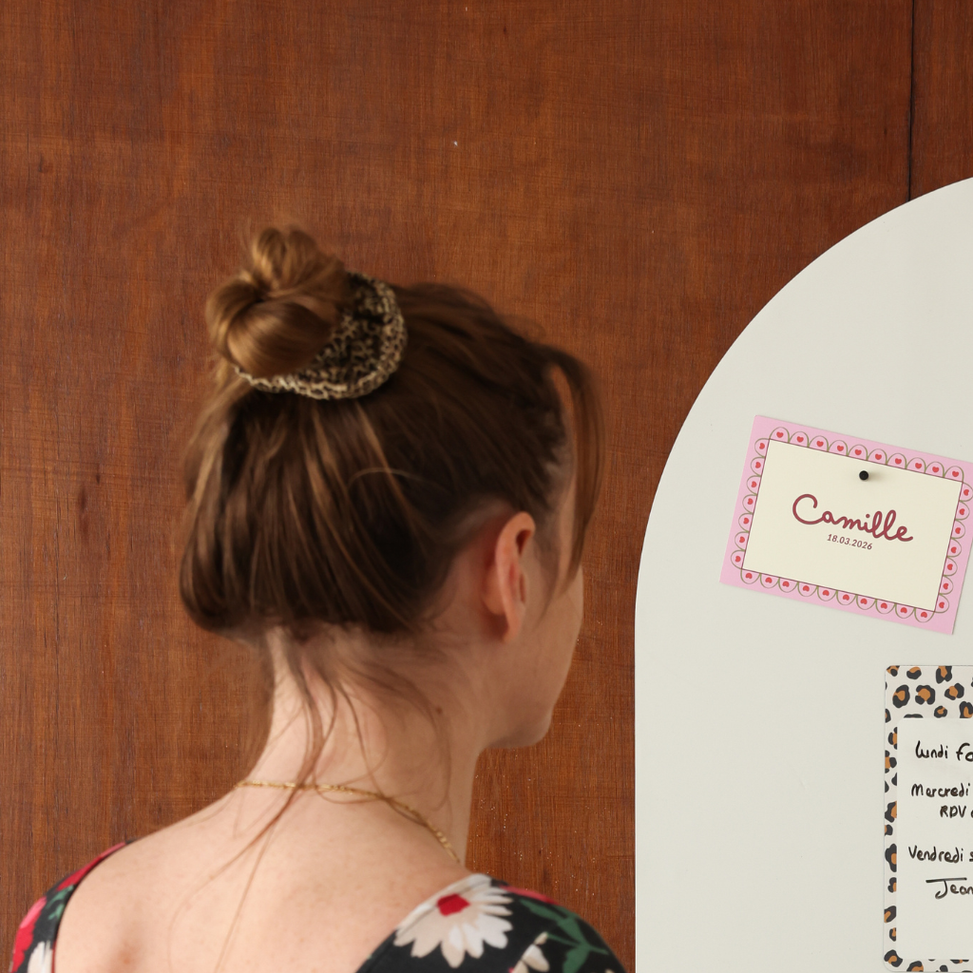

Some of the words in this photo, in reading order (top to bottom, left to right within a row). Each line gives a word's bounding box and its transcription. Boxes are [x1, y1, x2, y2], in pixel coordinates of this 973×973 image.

[792, 493, 914, 542] Camille
[827, 532, 874, 551] 18.03.2026
[911, 782, 971, 798] Mercredi
[939, 804, 967, 819] RDV
[908, 844, 964, 864] Vendredi
